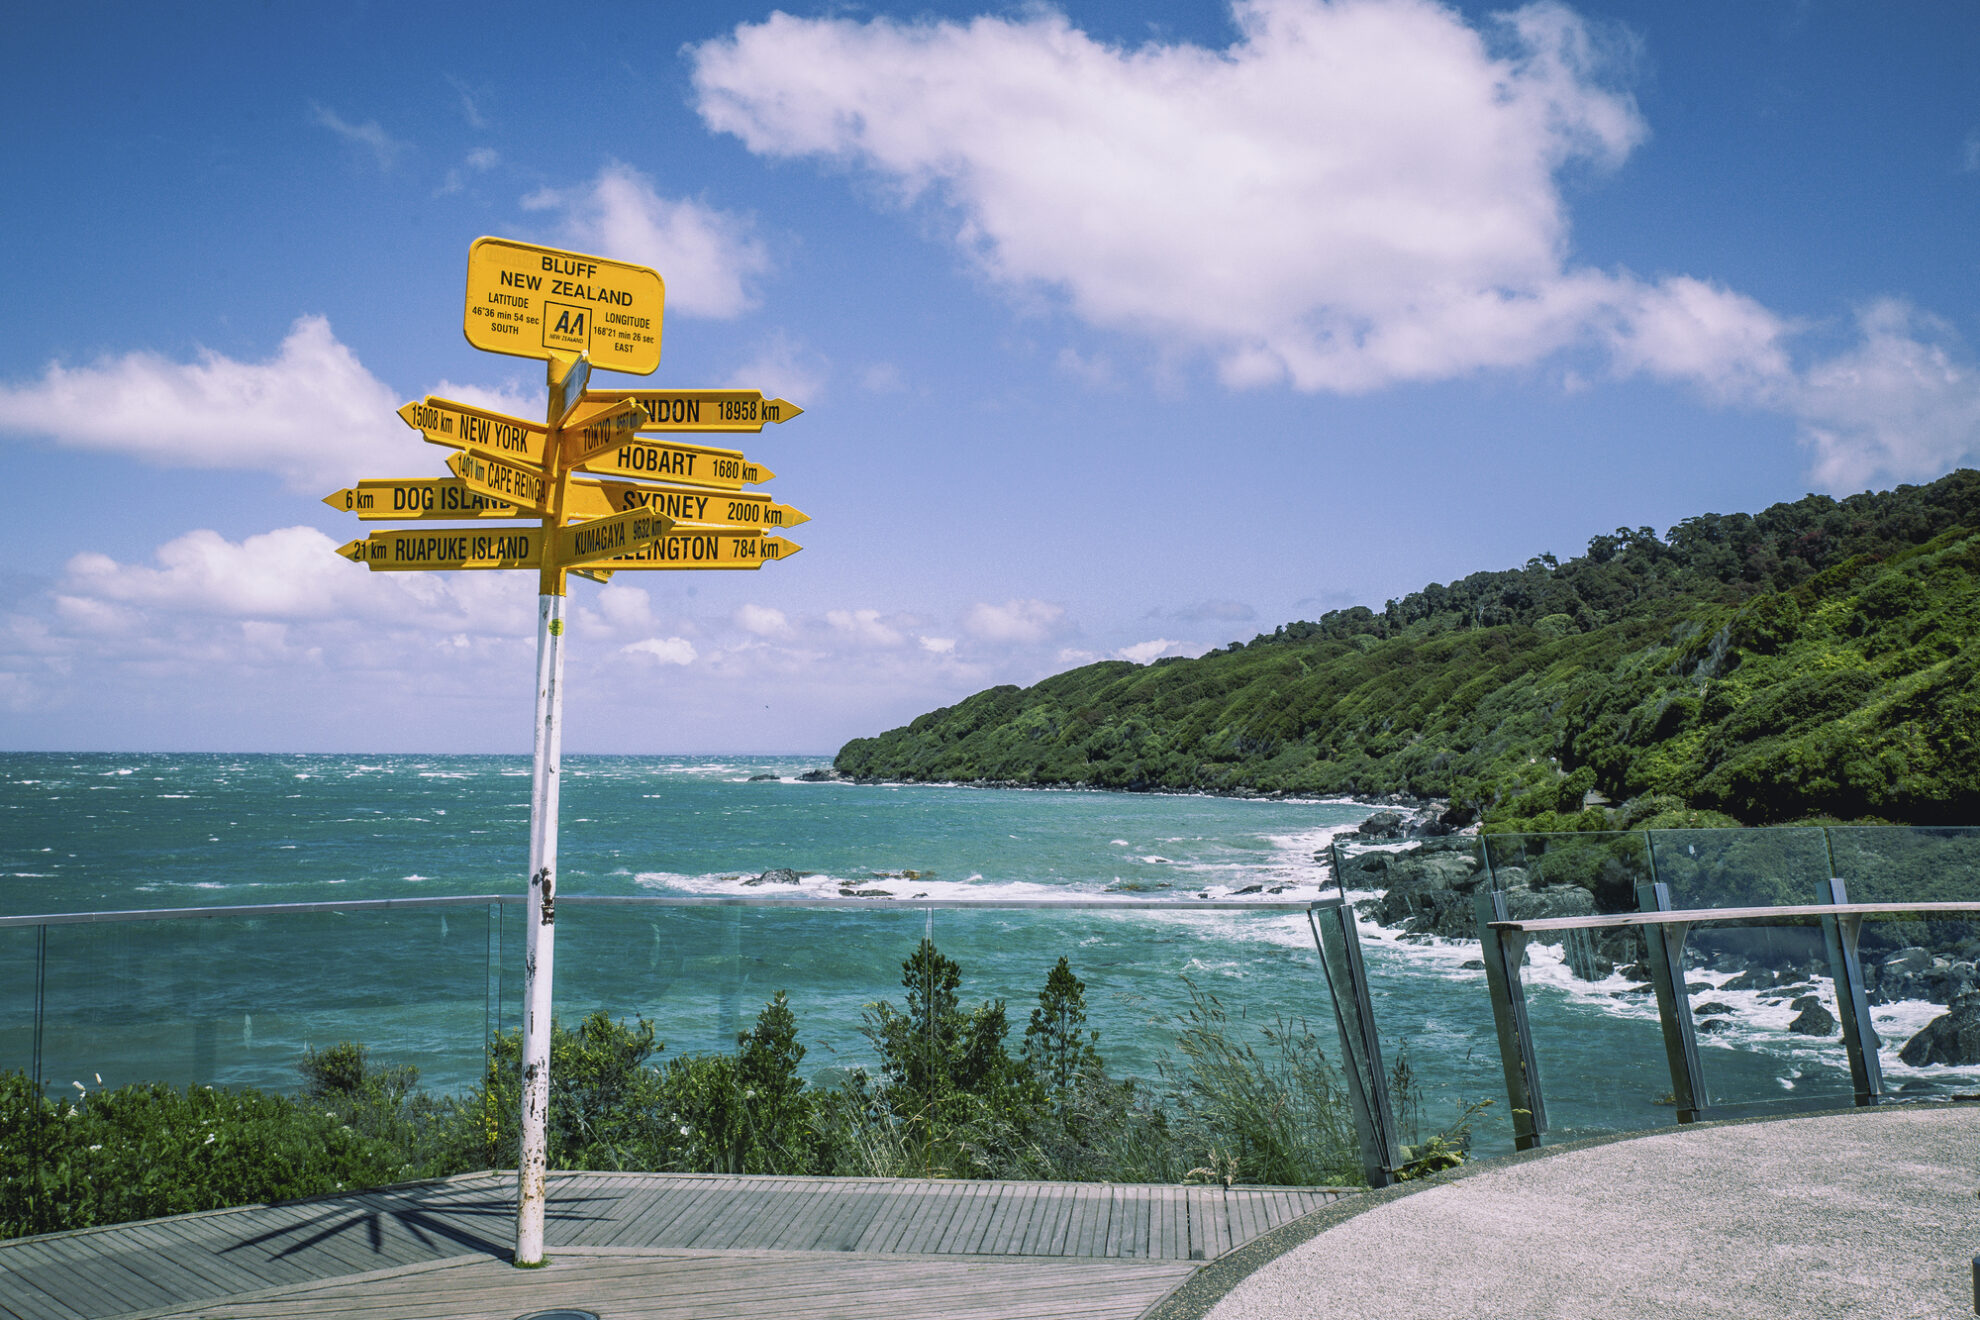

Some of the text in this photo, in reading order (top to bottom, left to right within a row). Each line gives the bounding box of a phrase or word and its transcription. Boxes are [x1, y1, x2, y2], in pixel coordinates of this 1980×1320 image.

[541, 256, 598, 279] BLUFF
[488, 292, 530, 309] LATITUDE
[500, 270, 634, 307] NEW ZEALAND
[491, 322, 520, 336] SOUTH
[496, 311, 512, 321] min
[513, 312, 524, 323] 54
[525, 316, 540, 326] sec
[553, 310, 584, 337] AA
[605, 312, 651, 330] LONGITUDE
[614, 342, 634, 354] EAST
[642, 335, 655, 345] sec
[618, 399, 780, 423] NDON 18958 km
[411, 404, 529, 454] 15008 km NEW YORK
[583, 417, 611, 453] TOKYO
[617, 446, 758, 481] HOBART 1680 km
[474, 460, 485, 483] km
[487, 462, 512, 494] CAPE
[514, 471, 546, 505] REINGA
[345, 490, 353, 509] 6
[356, 490, 374, 509] km
[393, 486, 434, 511] DOG
[622, 490, 782, 525] SYDNEY 2000 km
[354, 536, 529, 561] 21 km RUAPUKE ISLAND
[574, 521, 626, 556] KUMAGAYA
[651, 517, 663, 537] km
[606, 536, 779, 561] NGTON 784 km
